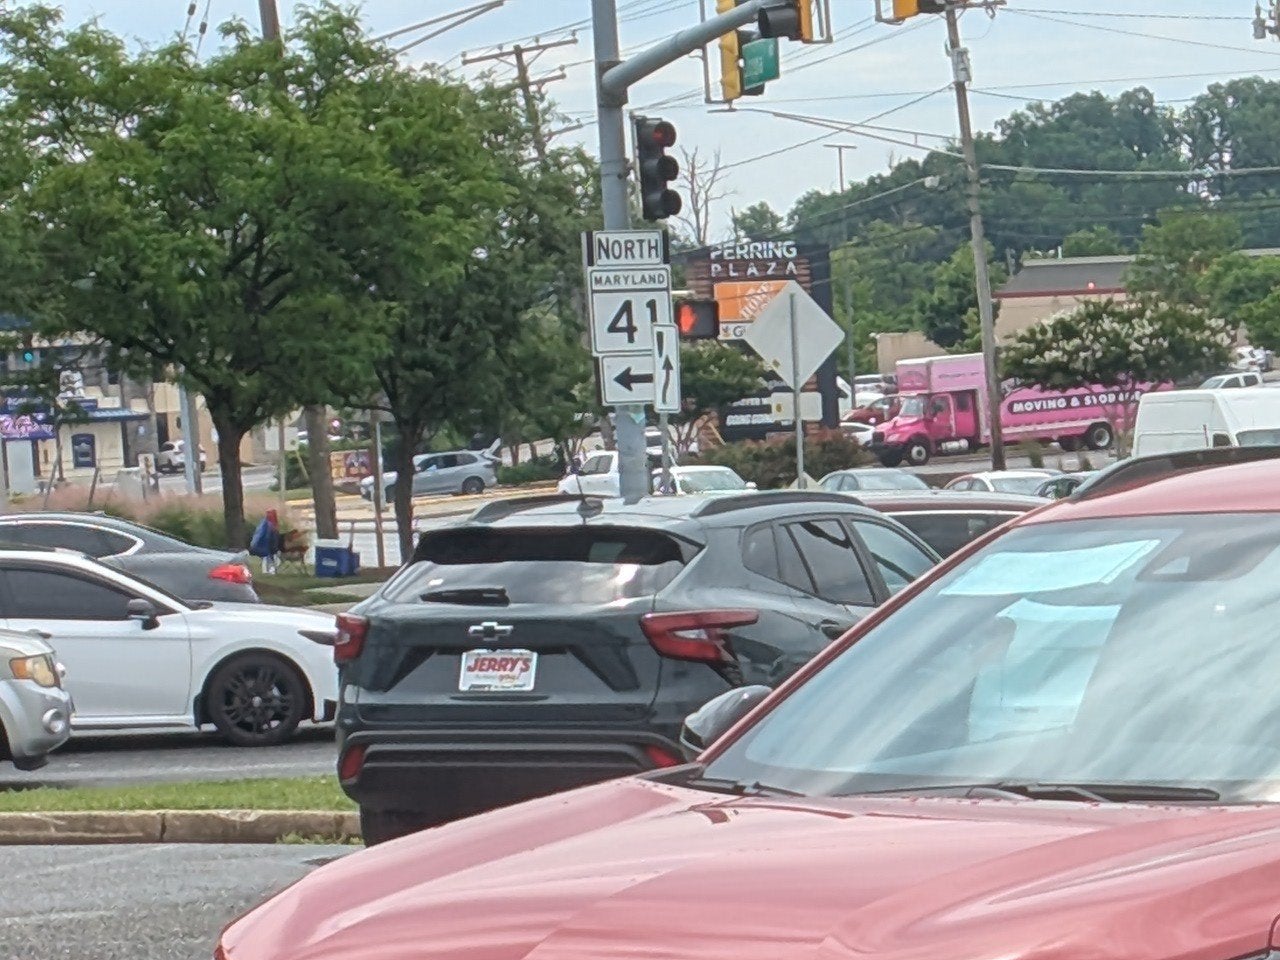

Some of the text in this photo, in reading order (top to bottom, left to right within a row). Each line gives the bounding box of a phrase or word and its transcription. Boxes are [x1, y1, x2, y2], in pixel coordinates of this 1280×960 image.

[597, 237, 660, 260] NORTH
[710, 240, 797, 260] PERRING
[711, 261, 798, 277] PLAZA
[594, 273, 666, 286] MARYLAND
[607, 298, 658, 344] 41
[1012, 397, 1067, 413] MOVING
[467, 656, 532, 672] JERRY'S
